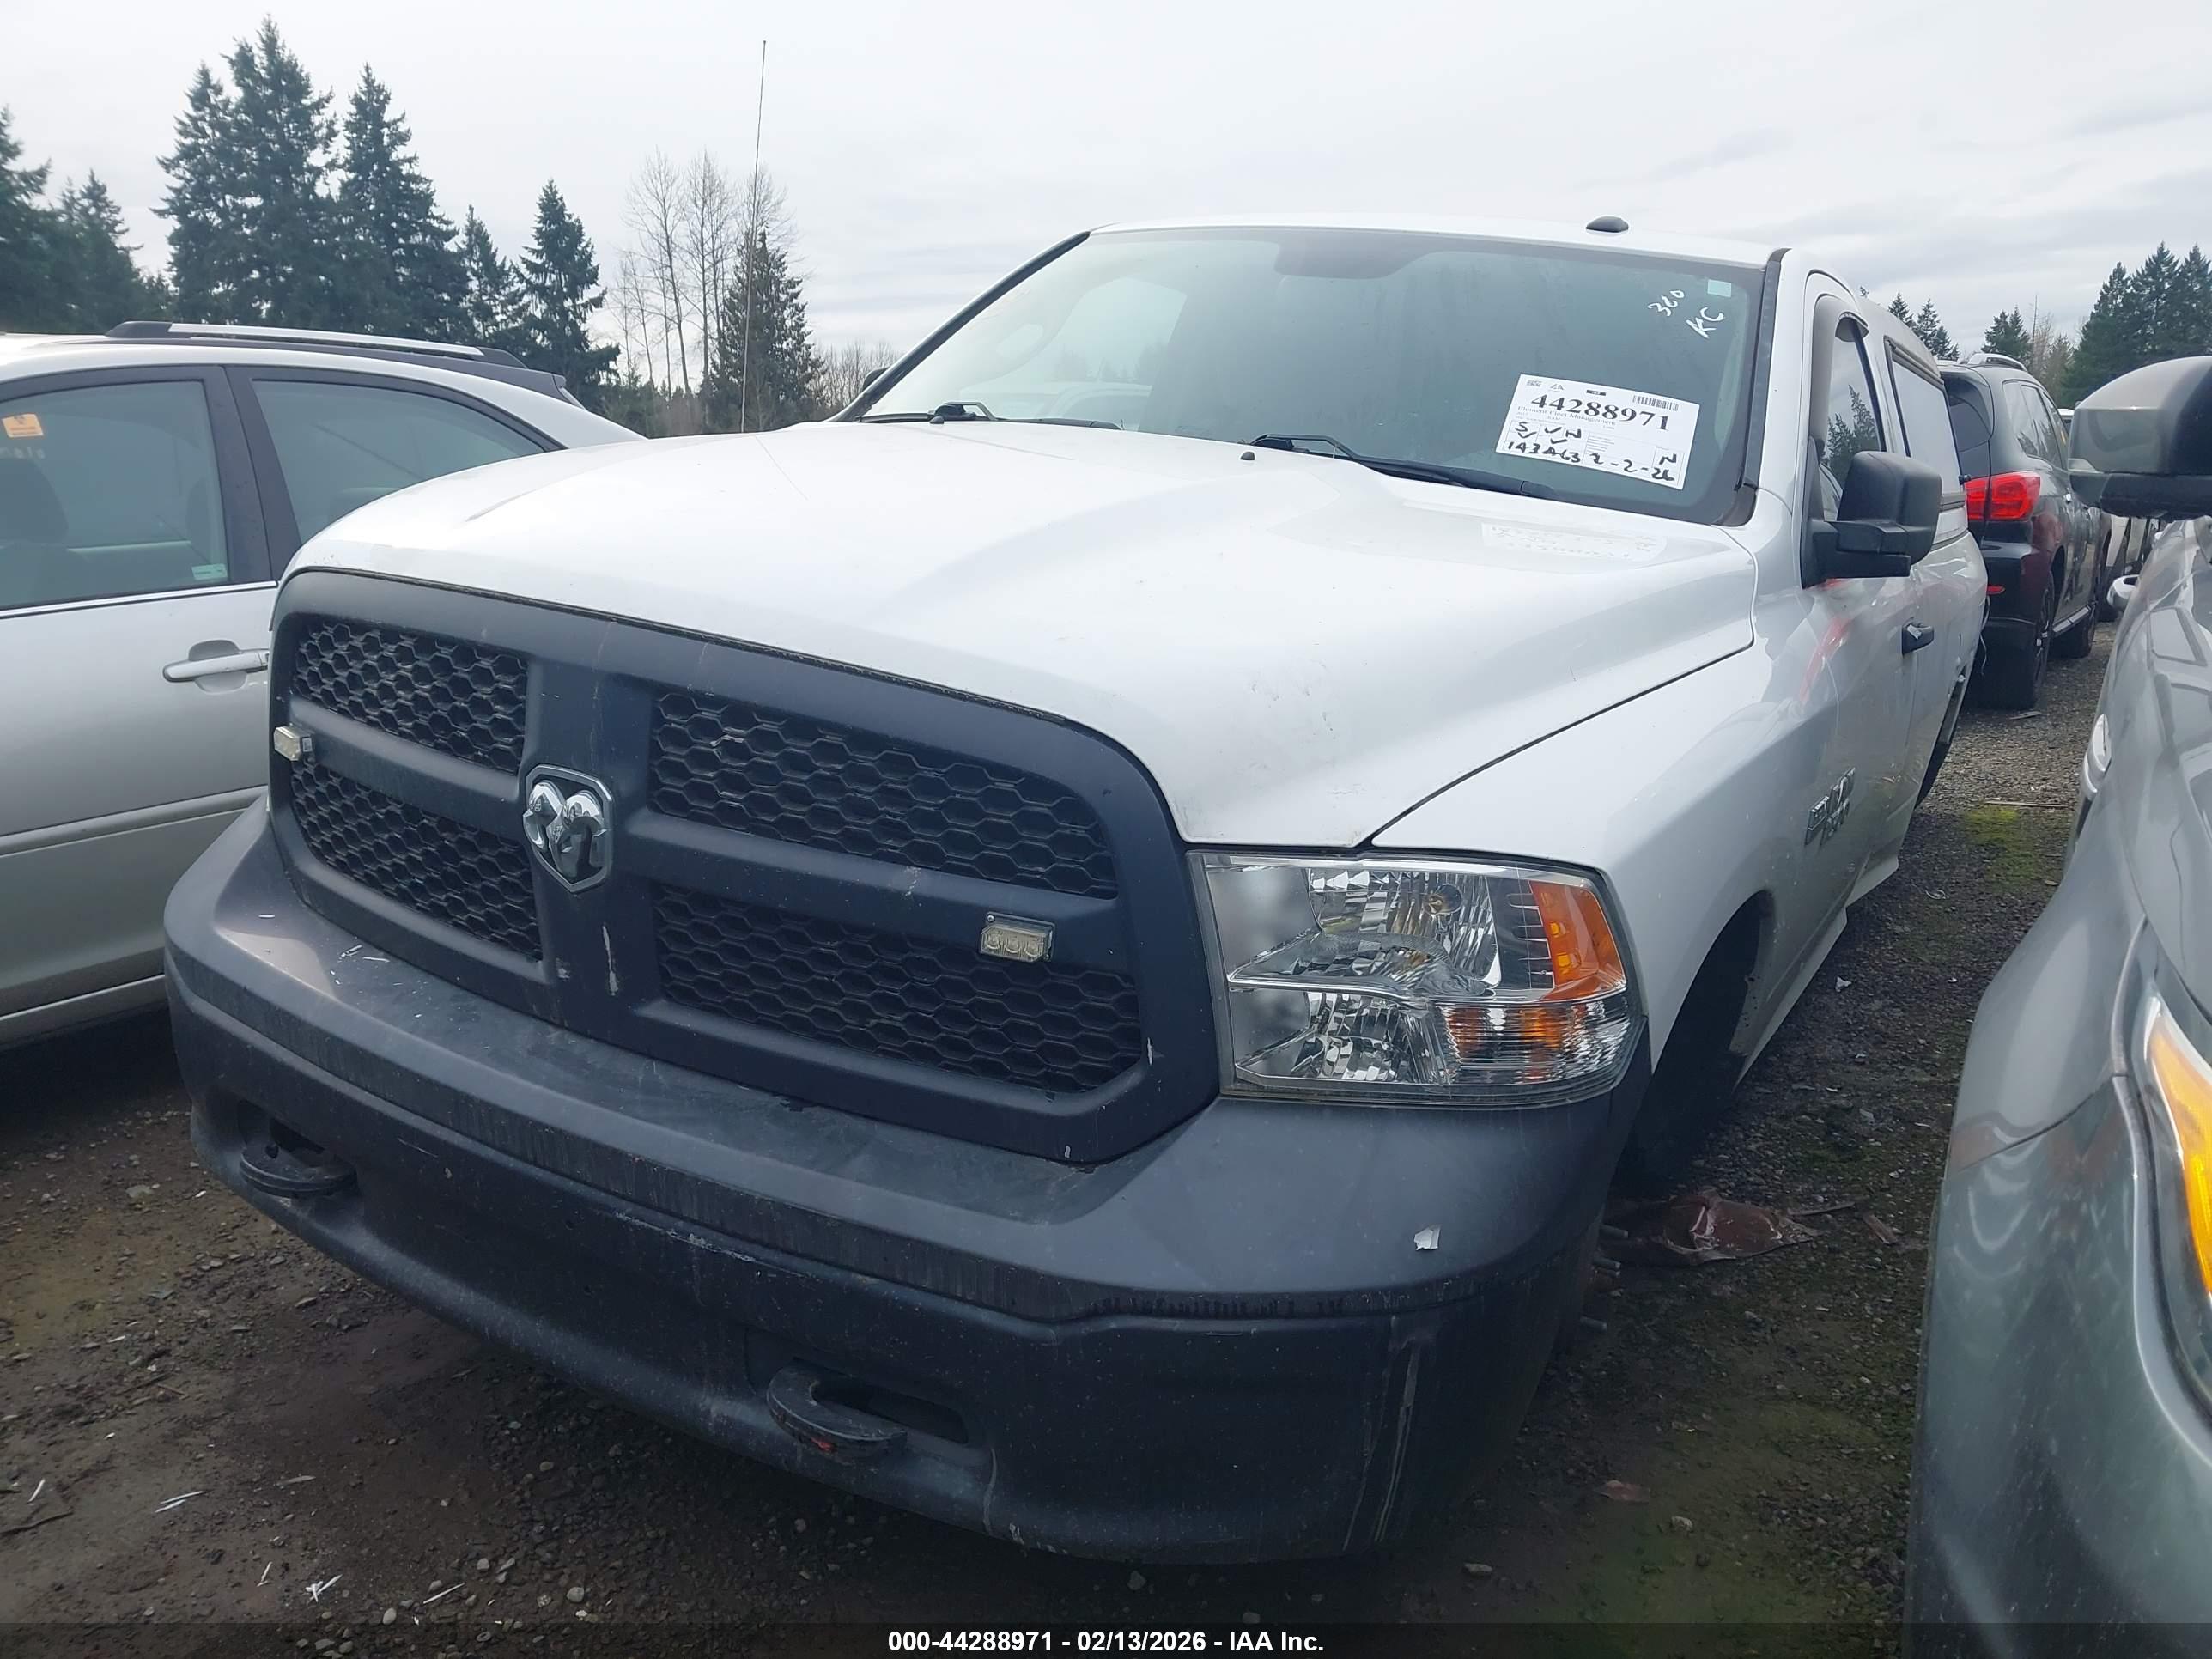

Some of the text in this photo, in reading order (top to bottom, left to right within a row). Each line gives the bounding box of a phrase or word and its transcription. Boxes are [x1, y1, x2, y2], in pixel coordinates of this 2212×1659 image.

[1647, 289, 1685, 317] 360
[1686, 307, 1724, 338] KC
[1531, 394, 1669, 431] 44288971
